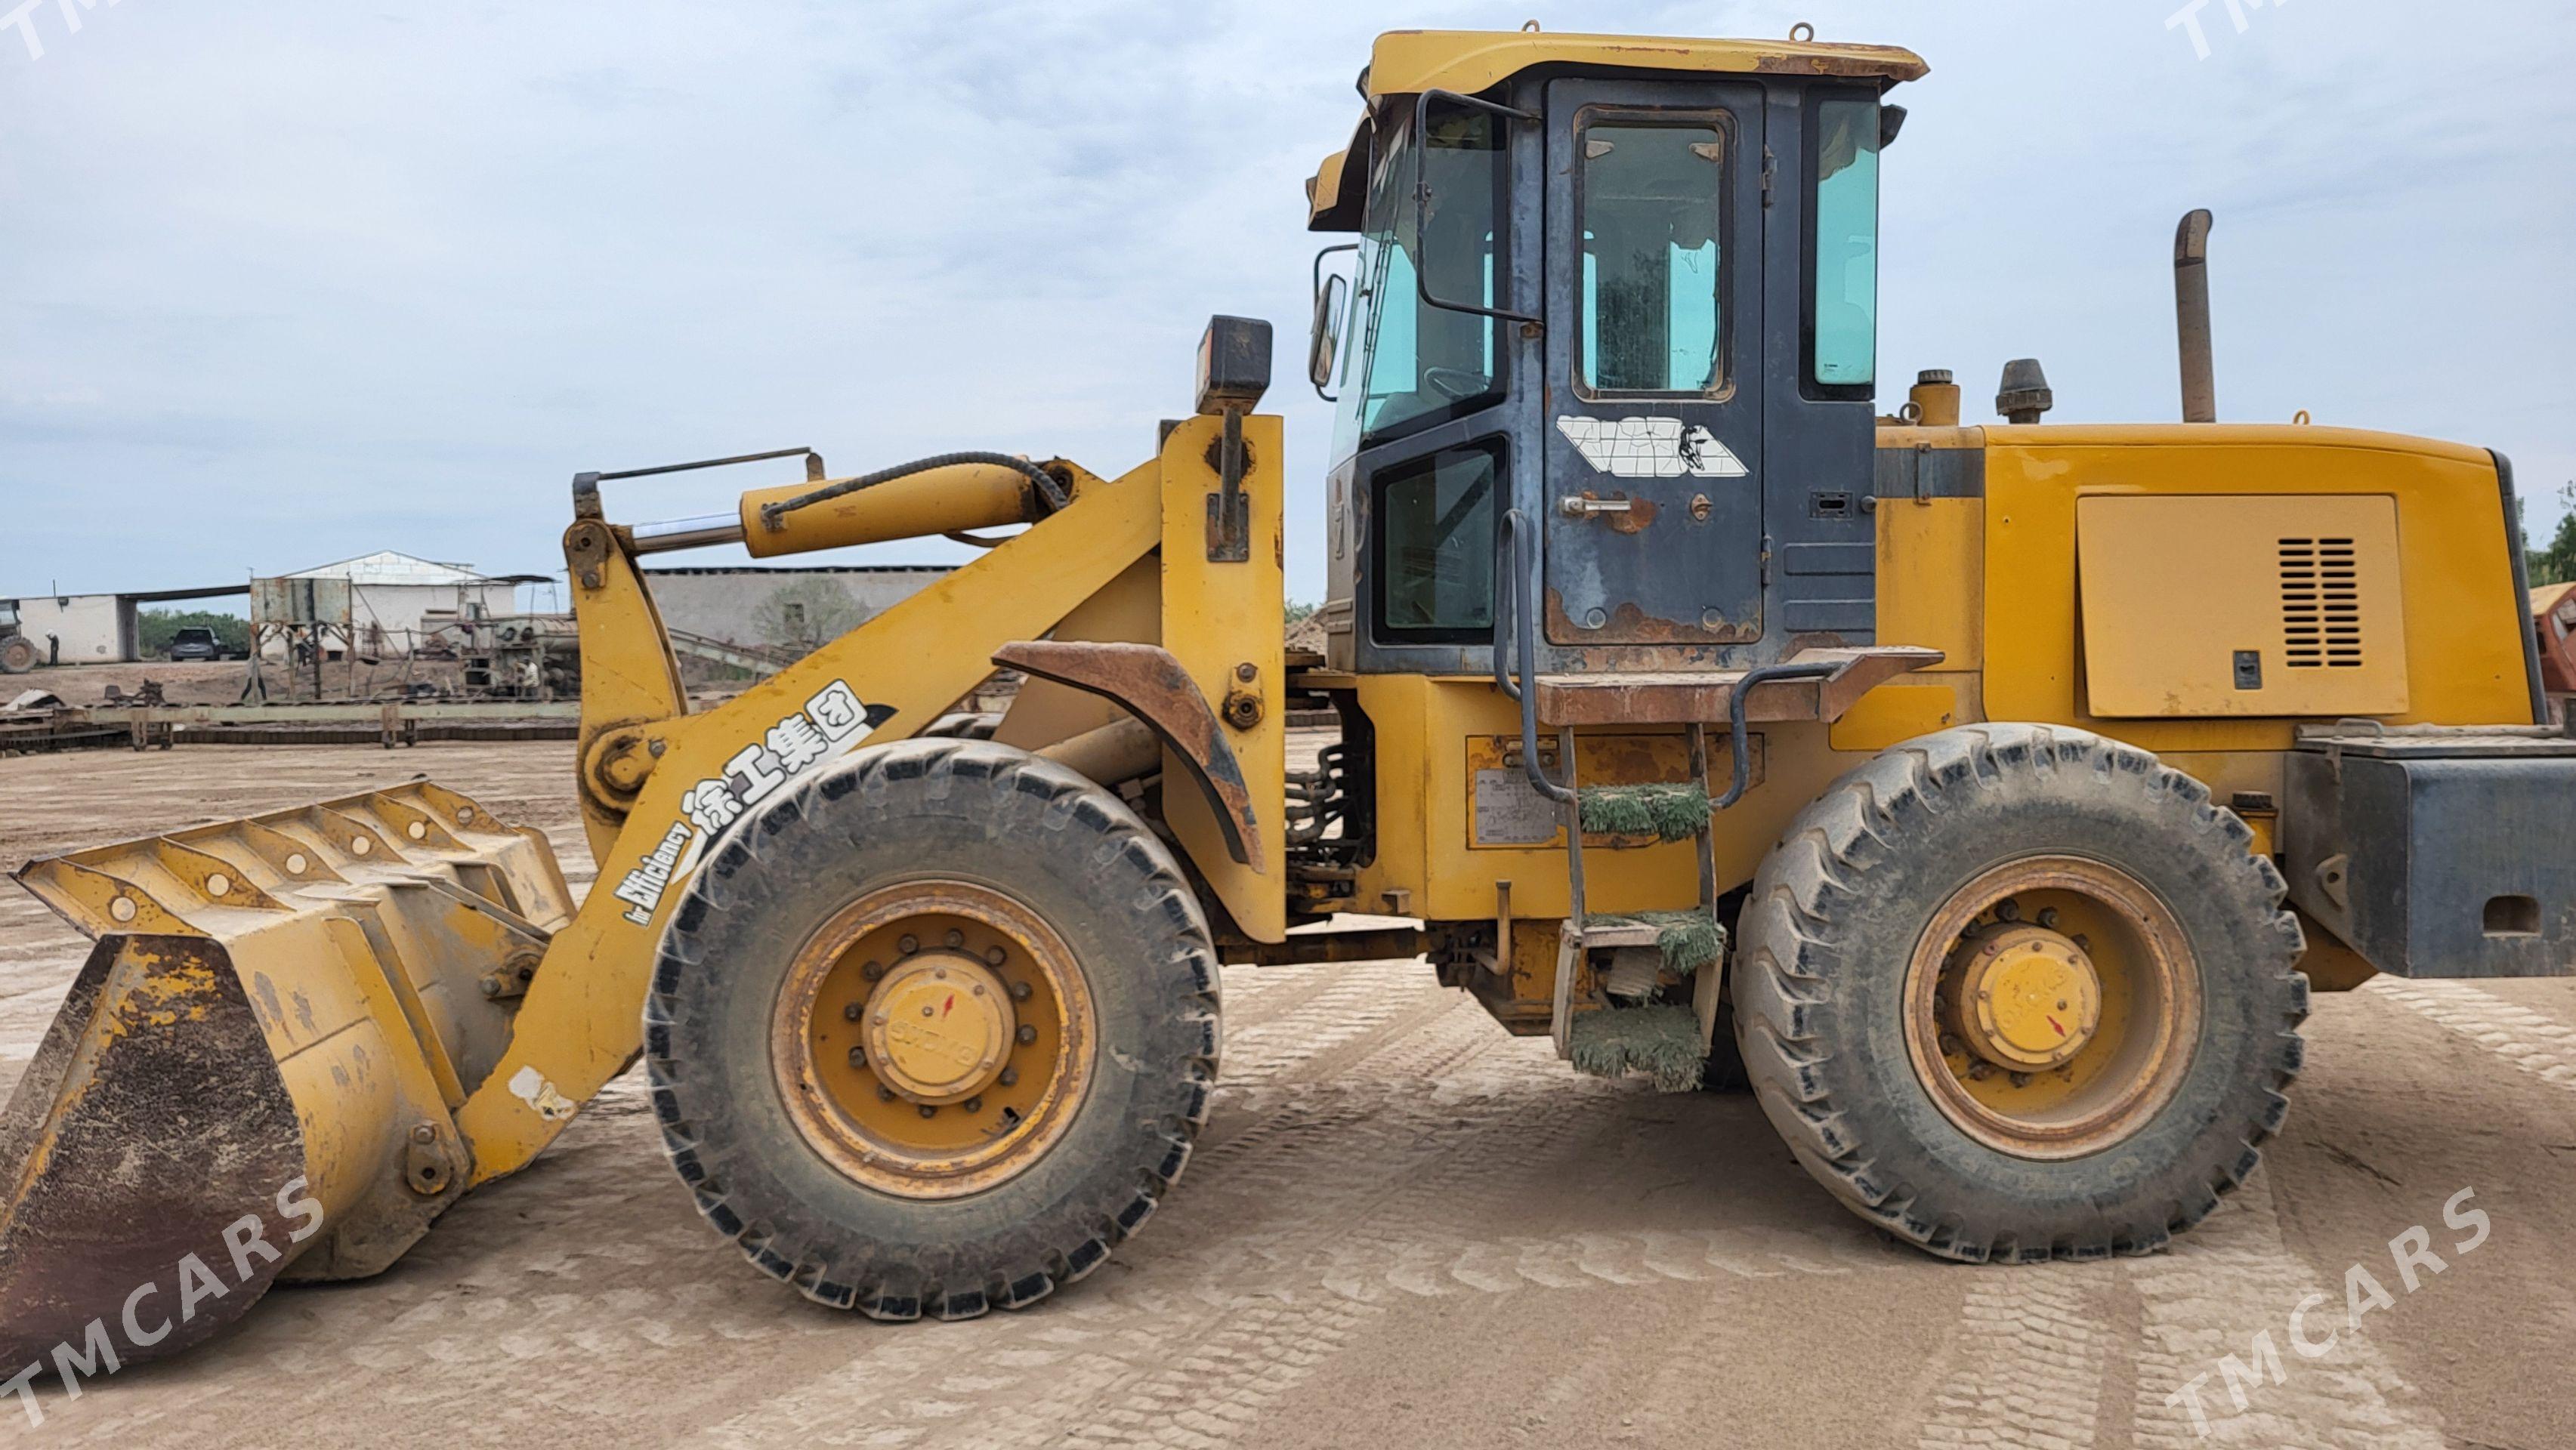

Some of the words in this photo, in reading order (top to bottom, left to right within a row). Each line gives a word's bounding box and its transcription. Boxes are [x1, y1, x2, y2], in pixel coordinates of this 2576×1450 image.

[681, 679, 868, 836] 徐工集团
[614, 821, 693, 912] Efficiency
